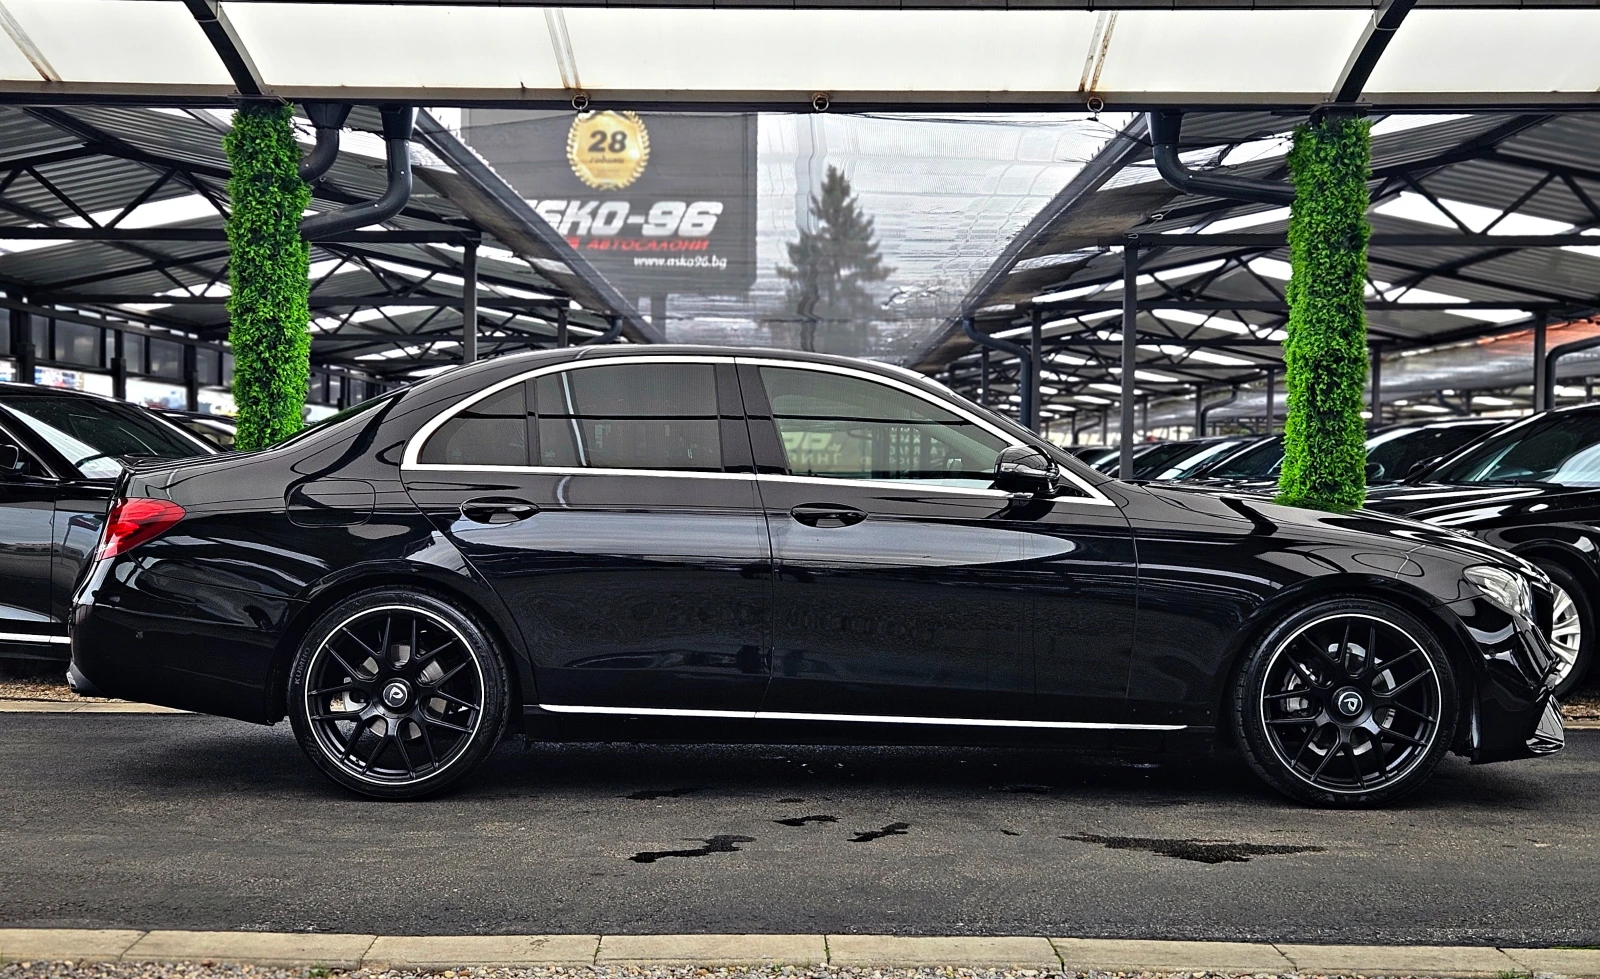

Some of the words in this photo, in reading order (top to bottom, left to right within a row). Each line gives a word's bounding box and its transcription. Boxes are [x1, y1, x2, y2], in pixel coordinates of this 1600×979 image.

[588, 130, 627, 153] 28
[525, 200, 723, 237] SKO-96
[633, 255, 728, 270] www.asko96.bg
[294, 647, 311, 685] KUMHO
